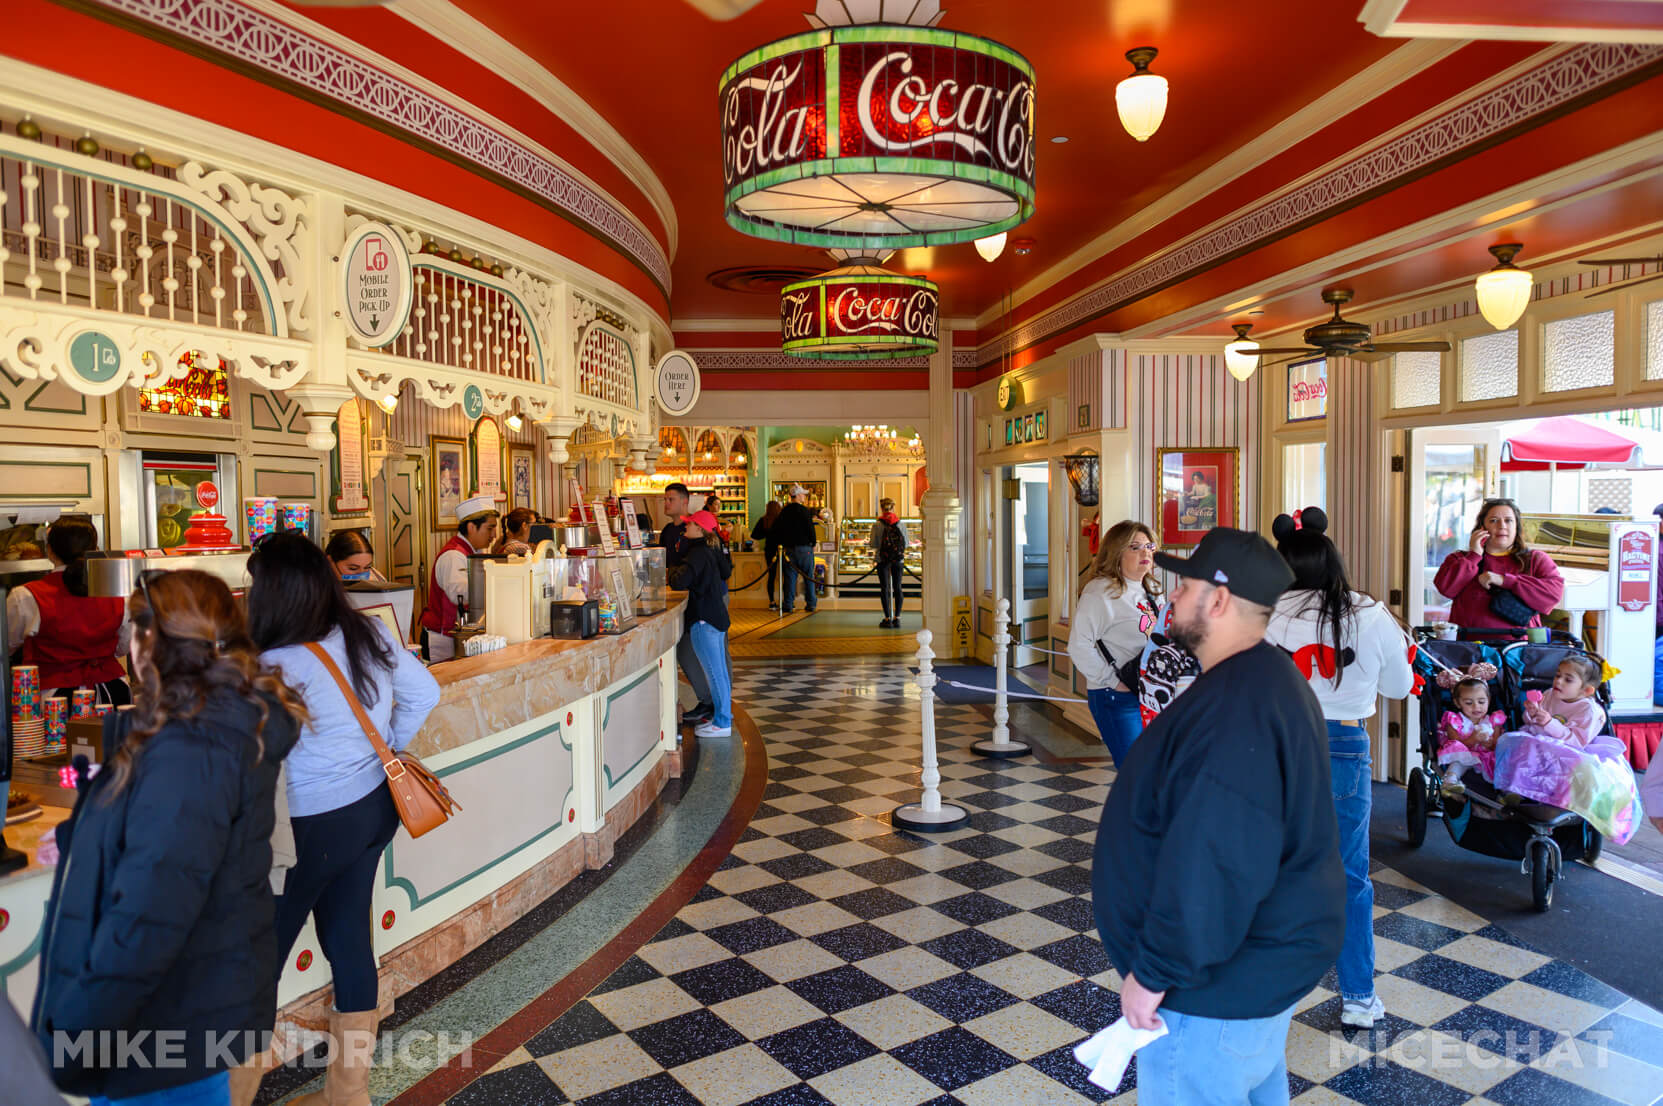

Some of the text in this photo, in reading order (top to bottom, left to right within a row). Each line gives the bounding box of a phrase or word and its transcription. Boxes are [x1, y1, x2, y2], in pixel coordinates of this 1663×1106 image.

[359, 274, 389, 287] MOBILE
[360, 288, 388, 300] ORDER
[359, 299, 391, 313] PICK UP
[92, 343, 99, 372] 1
[664, 372, 689, 381] ORDER
[668, 381, 686, 391] HERE
[471, 392, 480, 413] 2
